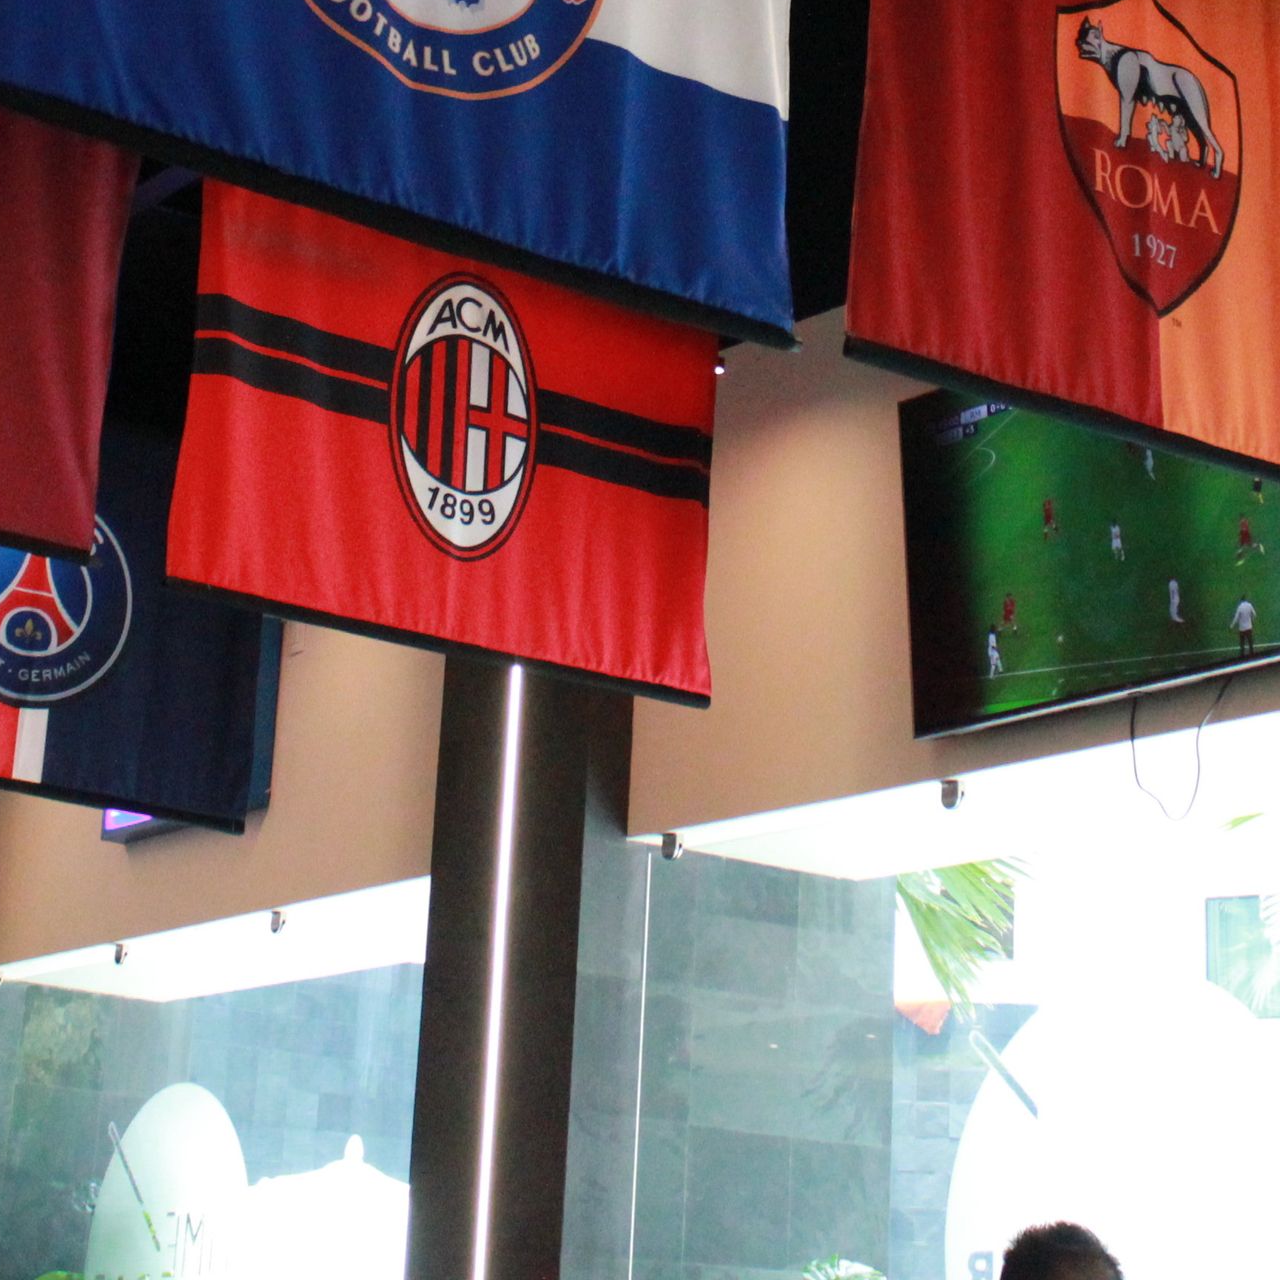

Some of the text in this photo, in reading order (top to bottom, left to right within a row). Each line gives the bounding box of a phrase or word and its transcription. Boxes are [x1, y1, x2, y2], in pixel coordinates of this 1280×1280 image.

[472, 32, 541, 78] CLUB
[1092, 147, 1222, 236] ROMA
[1131, 232, 1178, 269] 1927
[426, 296, 510, 355] ACM
[426, 485, 496, 526] 1899
[18, 651, 91, 683] GERMAIN
